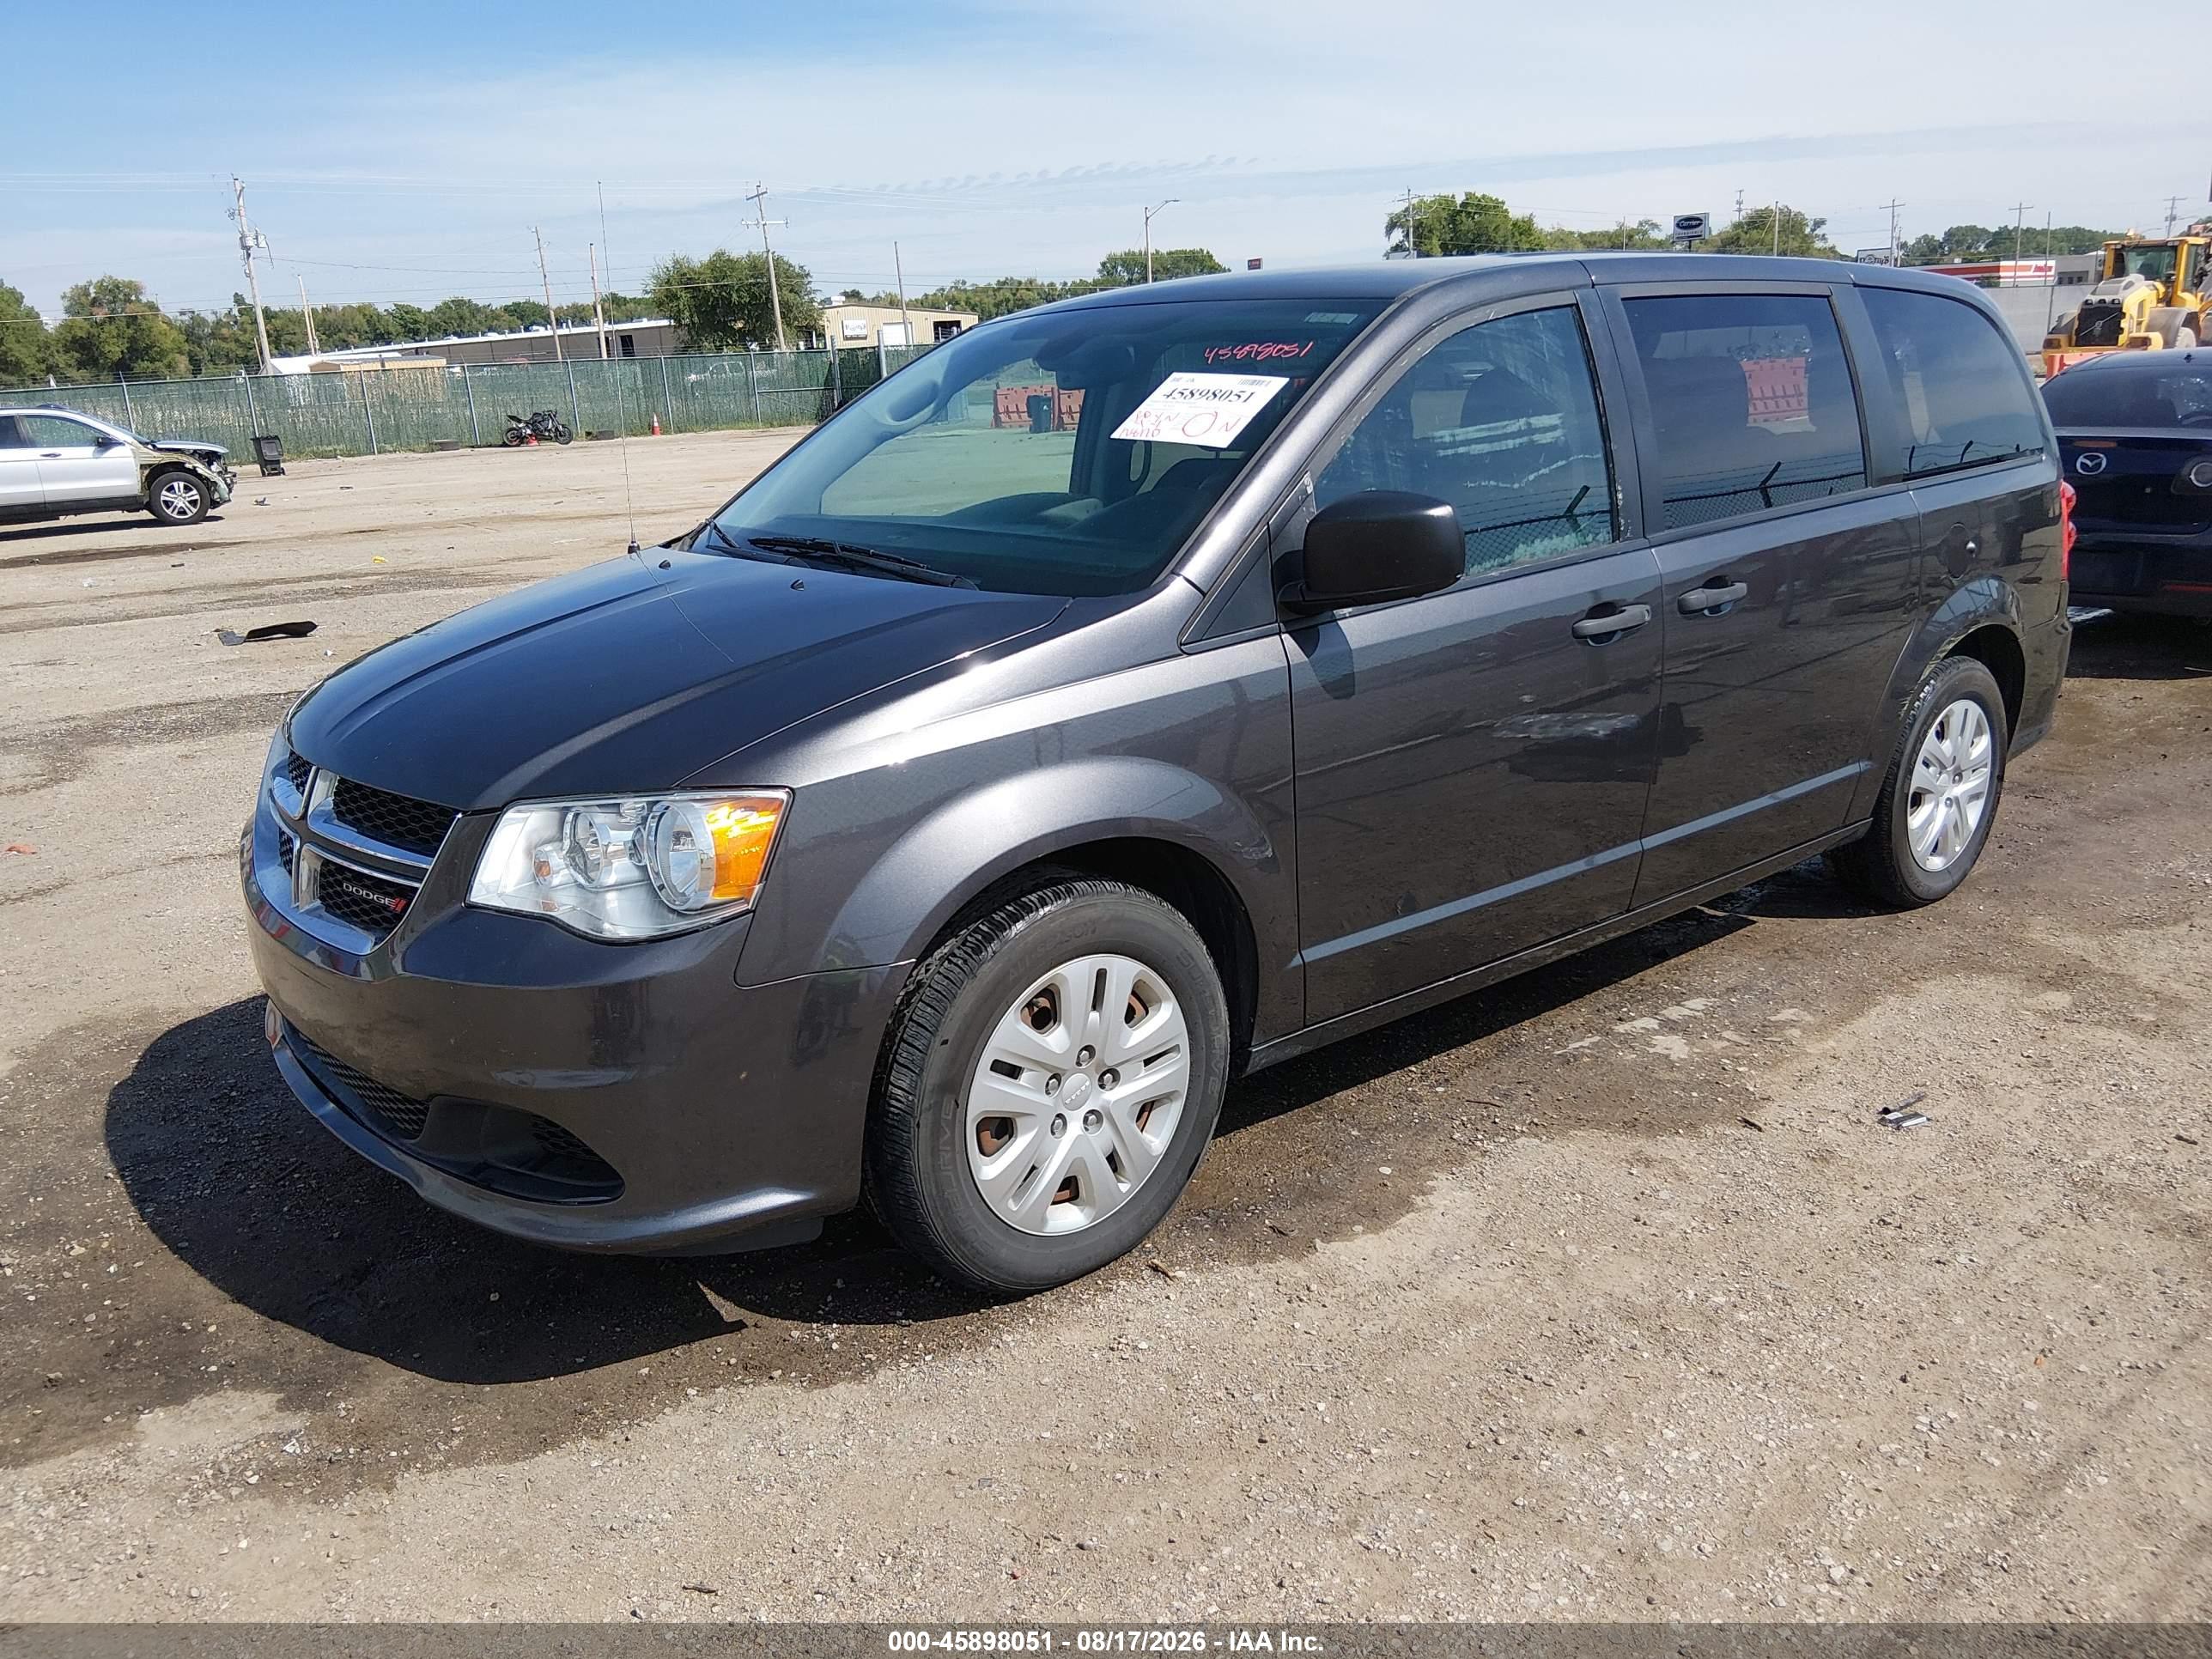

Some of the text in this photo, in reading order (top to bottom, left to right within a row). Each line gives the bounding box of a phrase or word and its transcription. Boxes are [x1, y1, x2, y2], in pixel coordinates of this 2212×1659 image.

[1204, 341, 1314, 365] 45898051
[1162, 387, 1256, 404] 45898051
[342, 882, 396, 908] DODGE
